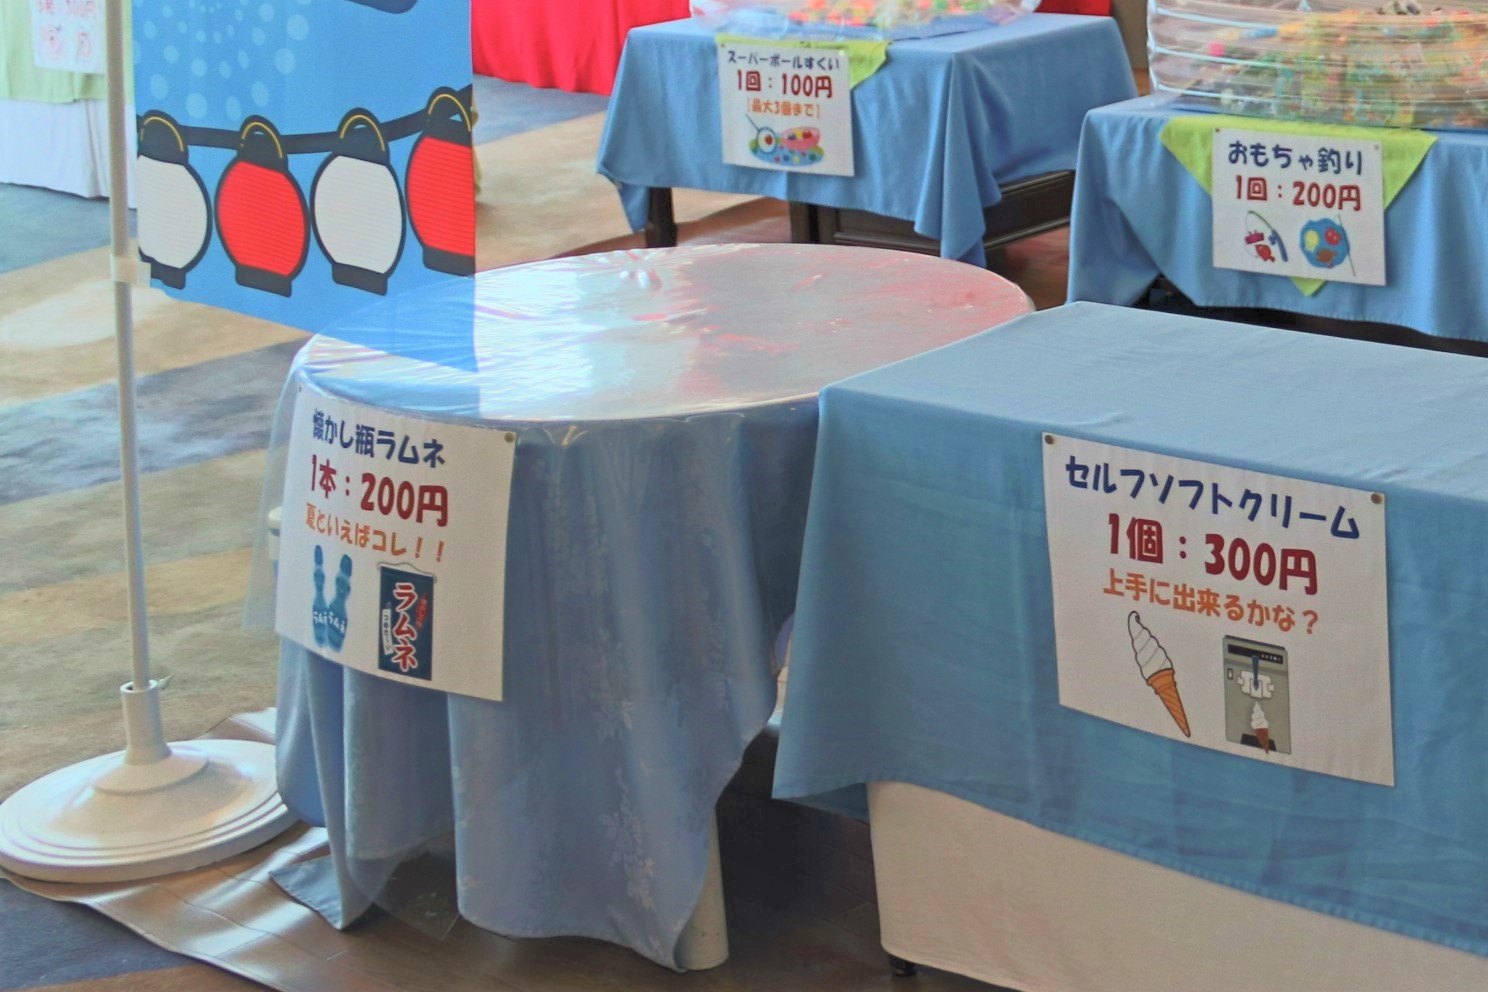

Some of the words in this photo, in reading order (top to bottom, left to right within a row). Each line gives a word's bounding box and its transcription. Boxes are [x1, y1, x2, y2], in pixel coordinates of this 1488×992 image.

[727, 50, 841, 71] スーパーボールすくい
[1228, 140, 1364, 176] おもちゃ釣り
[312, 408, 446, 469] 懐かし瓶ラムネ
[1065, 455, 1361, 540] セルフソフトクリーム
[391, 582, 419, 672] ラムネ
